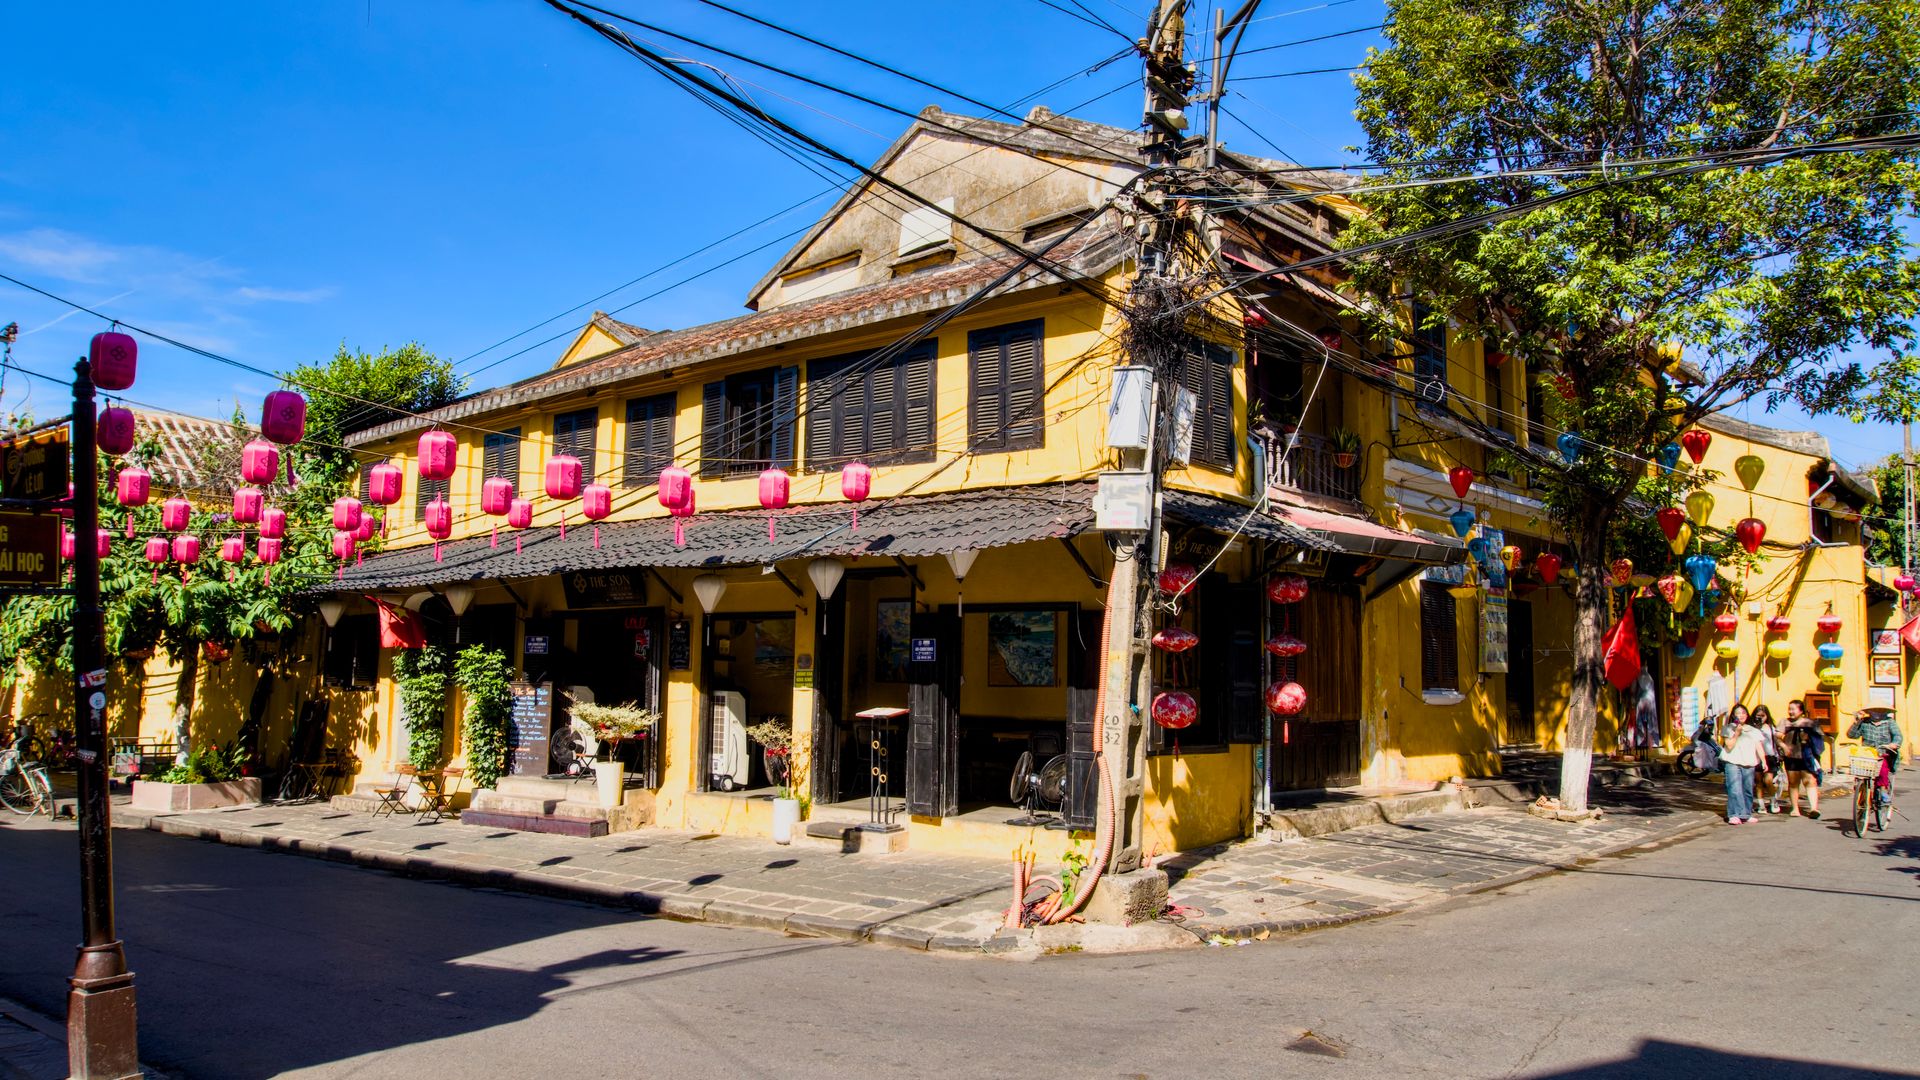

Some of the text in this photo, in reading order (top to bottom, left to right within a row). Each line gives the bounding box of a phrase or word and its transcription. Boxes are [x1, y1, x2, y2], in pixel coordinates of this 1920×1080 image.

[17, 552, 44, 576] HỌC
[588, 574, 630, 588] THE SON
